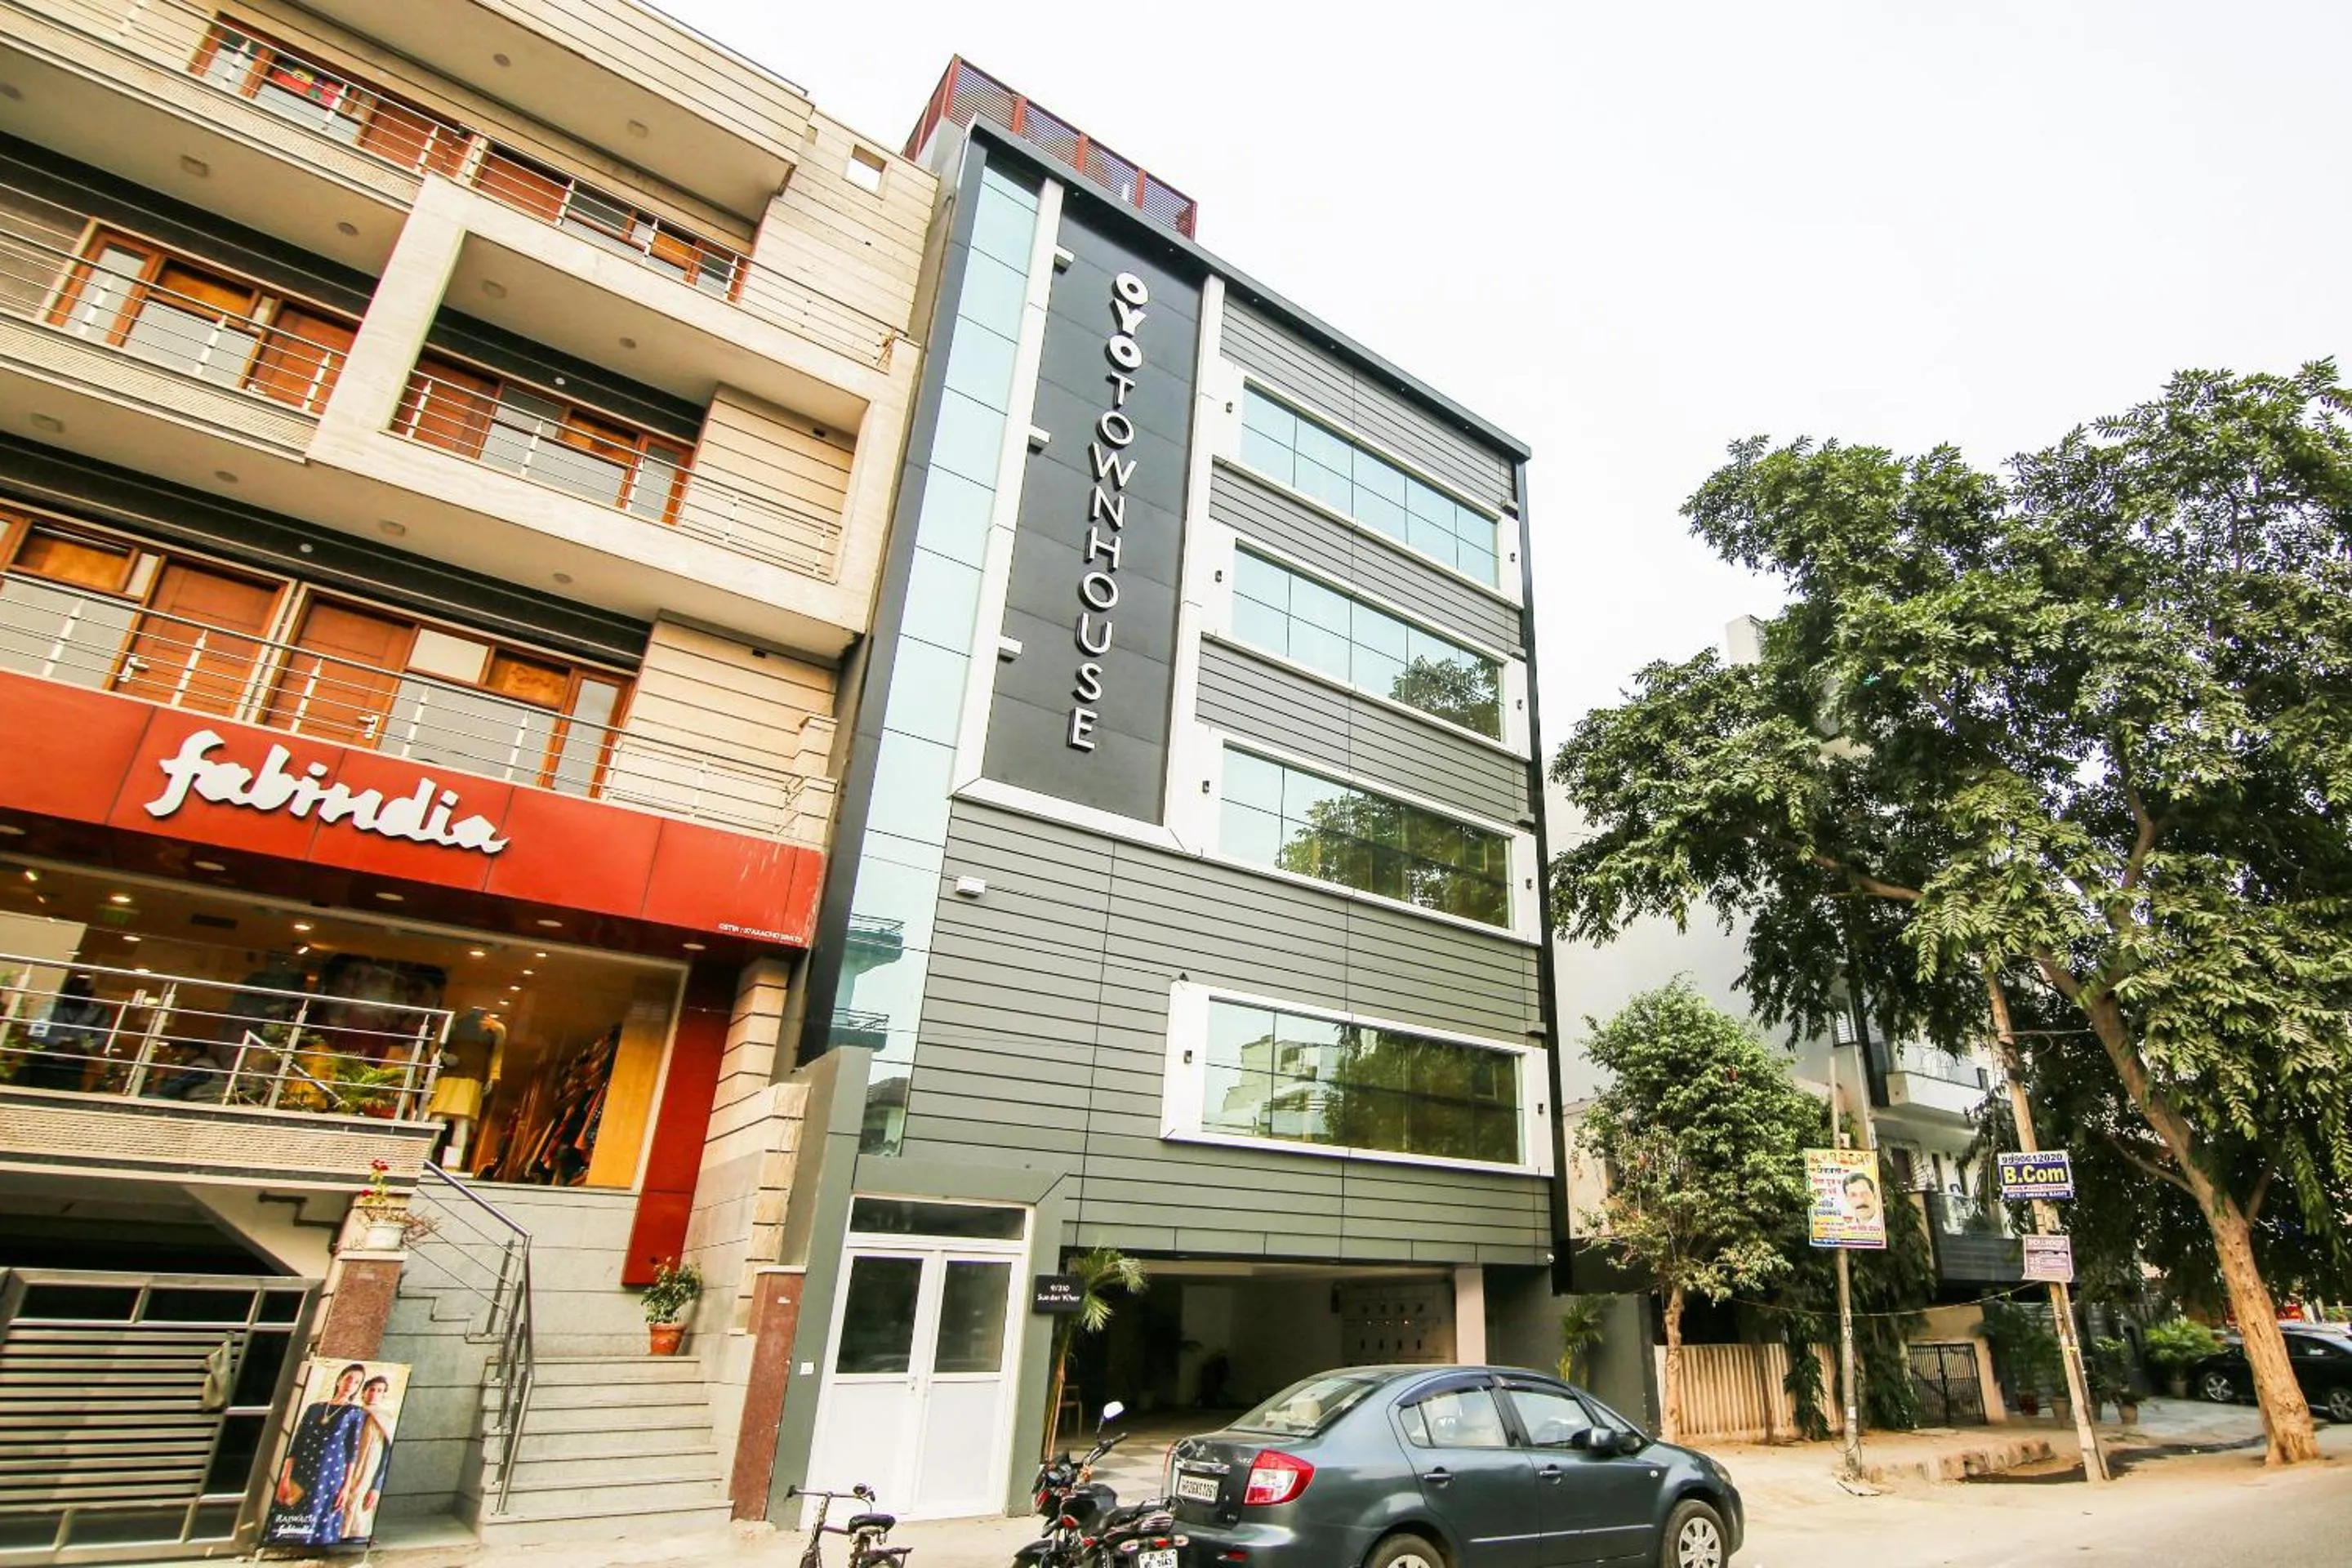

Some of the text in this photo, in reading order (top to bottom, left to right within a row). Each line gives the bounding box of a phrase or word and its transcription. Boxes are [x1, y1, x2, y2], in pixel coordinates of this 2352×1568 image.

[1069, 272, 1149, 750] OYO TOWNHOUSE
[144, 729, 512, 854] fabindia
[2002, 1165, 2066, 1184] B.Com
